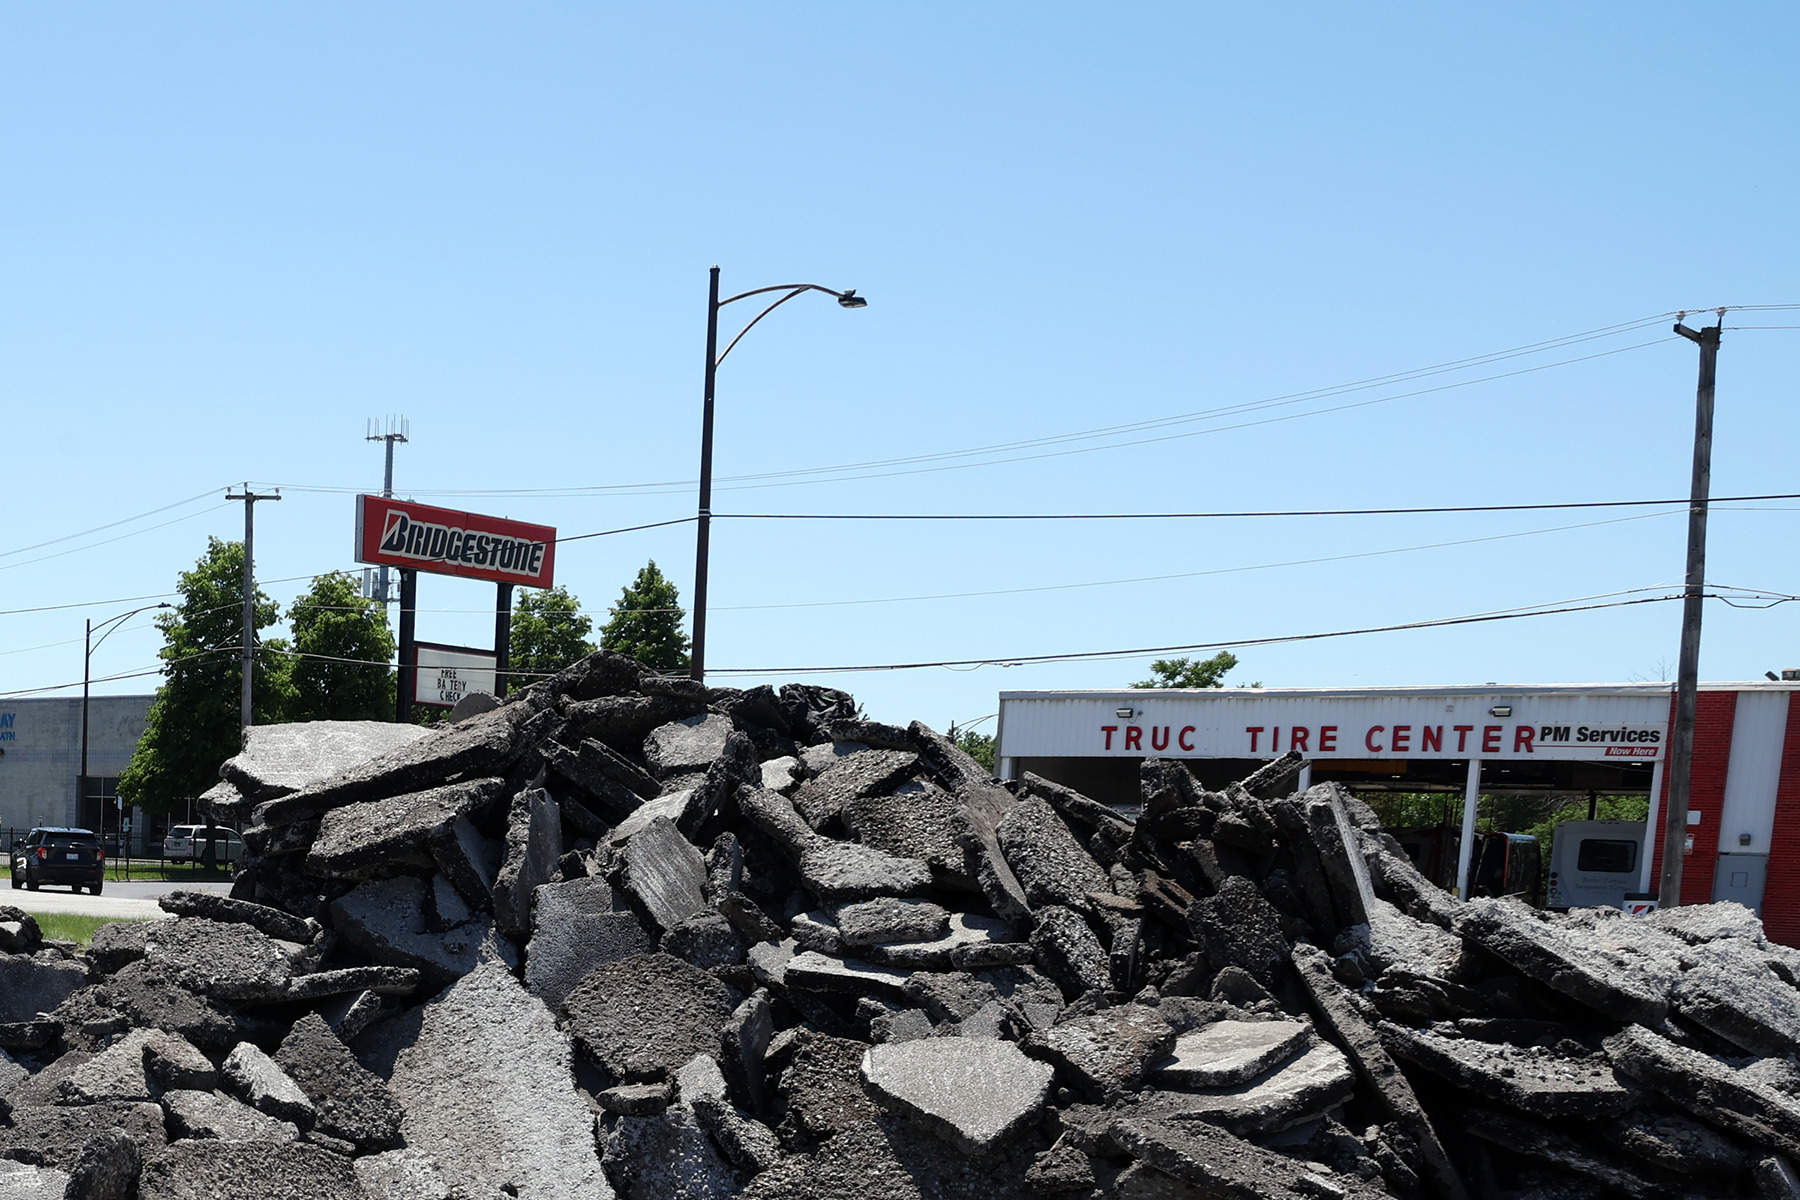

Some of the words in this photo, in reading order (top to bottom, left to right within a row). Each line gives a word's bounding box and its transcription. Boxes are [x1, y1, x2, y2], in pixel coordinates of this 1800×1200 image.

[380, 514, 545, 574] BRIDGESTONE
[441, 669, 457, 680] FREE
[440, 690, 461, 702] CHECK
[1246, 726, 1338, 753] TIRE
[1365, 725, 1535, 753] CENTER
[1539, 726, 1571, 742] PM
[1576, 726, 1661, 743] Services
[1608, 746, 1632, 756] Now
[1632, 747, 1656, 756] Here
